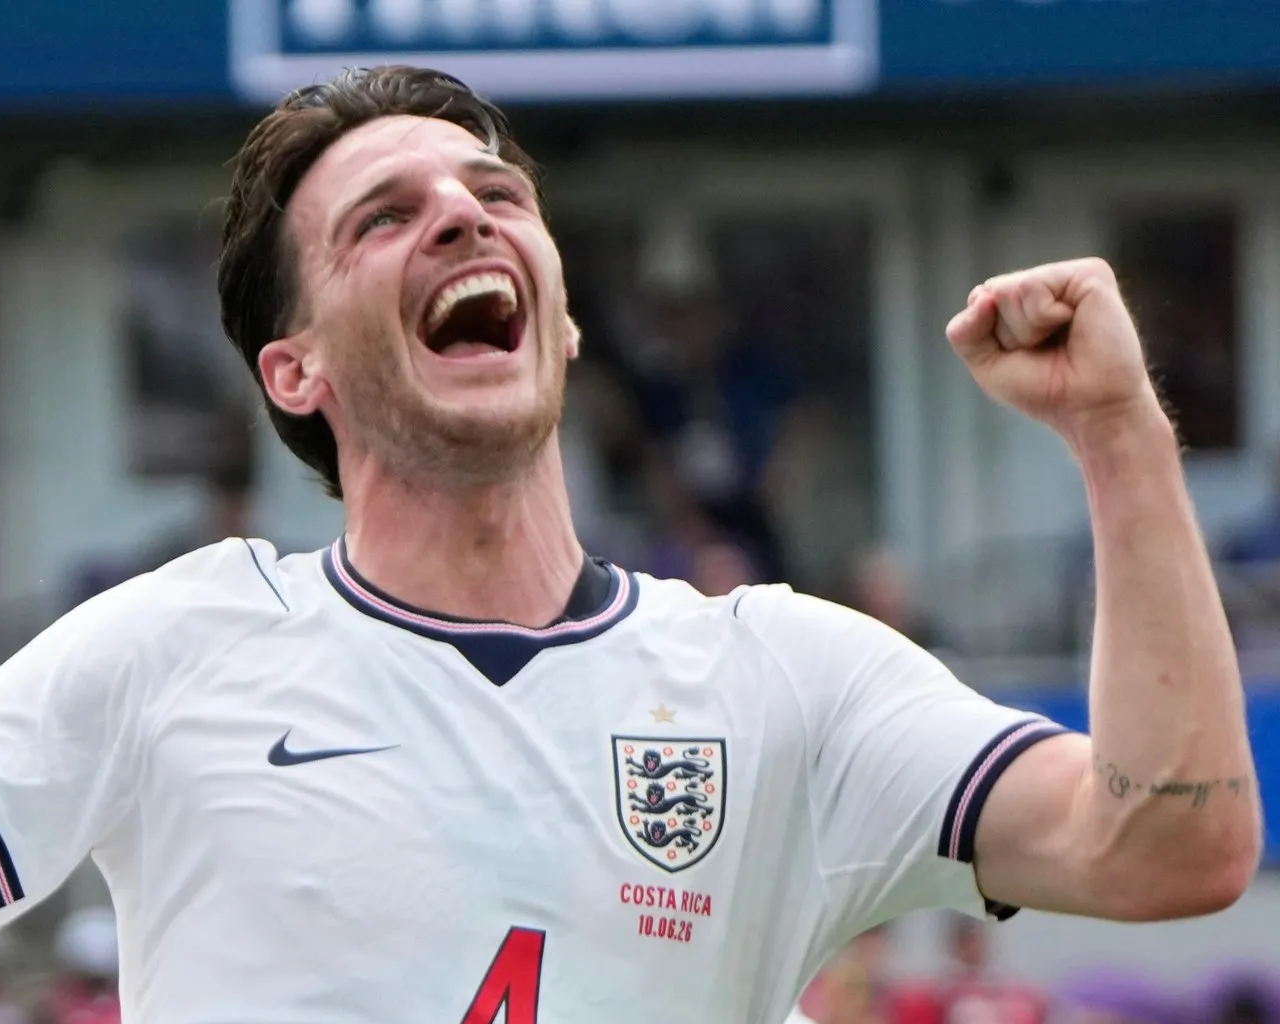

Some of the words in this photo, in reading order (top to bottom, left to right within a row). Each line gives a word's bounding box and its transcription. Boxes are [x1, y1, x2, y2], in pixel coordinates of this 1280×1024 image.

[620, 883, 677, 909] COSTA
[680, 889, 712, 916] RICA
[638, 914, 693, 942] 10.06.26
